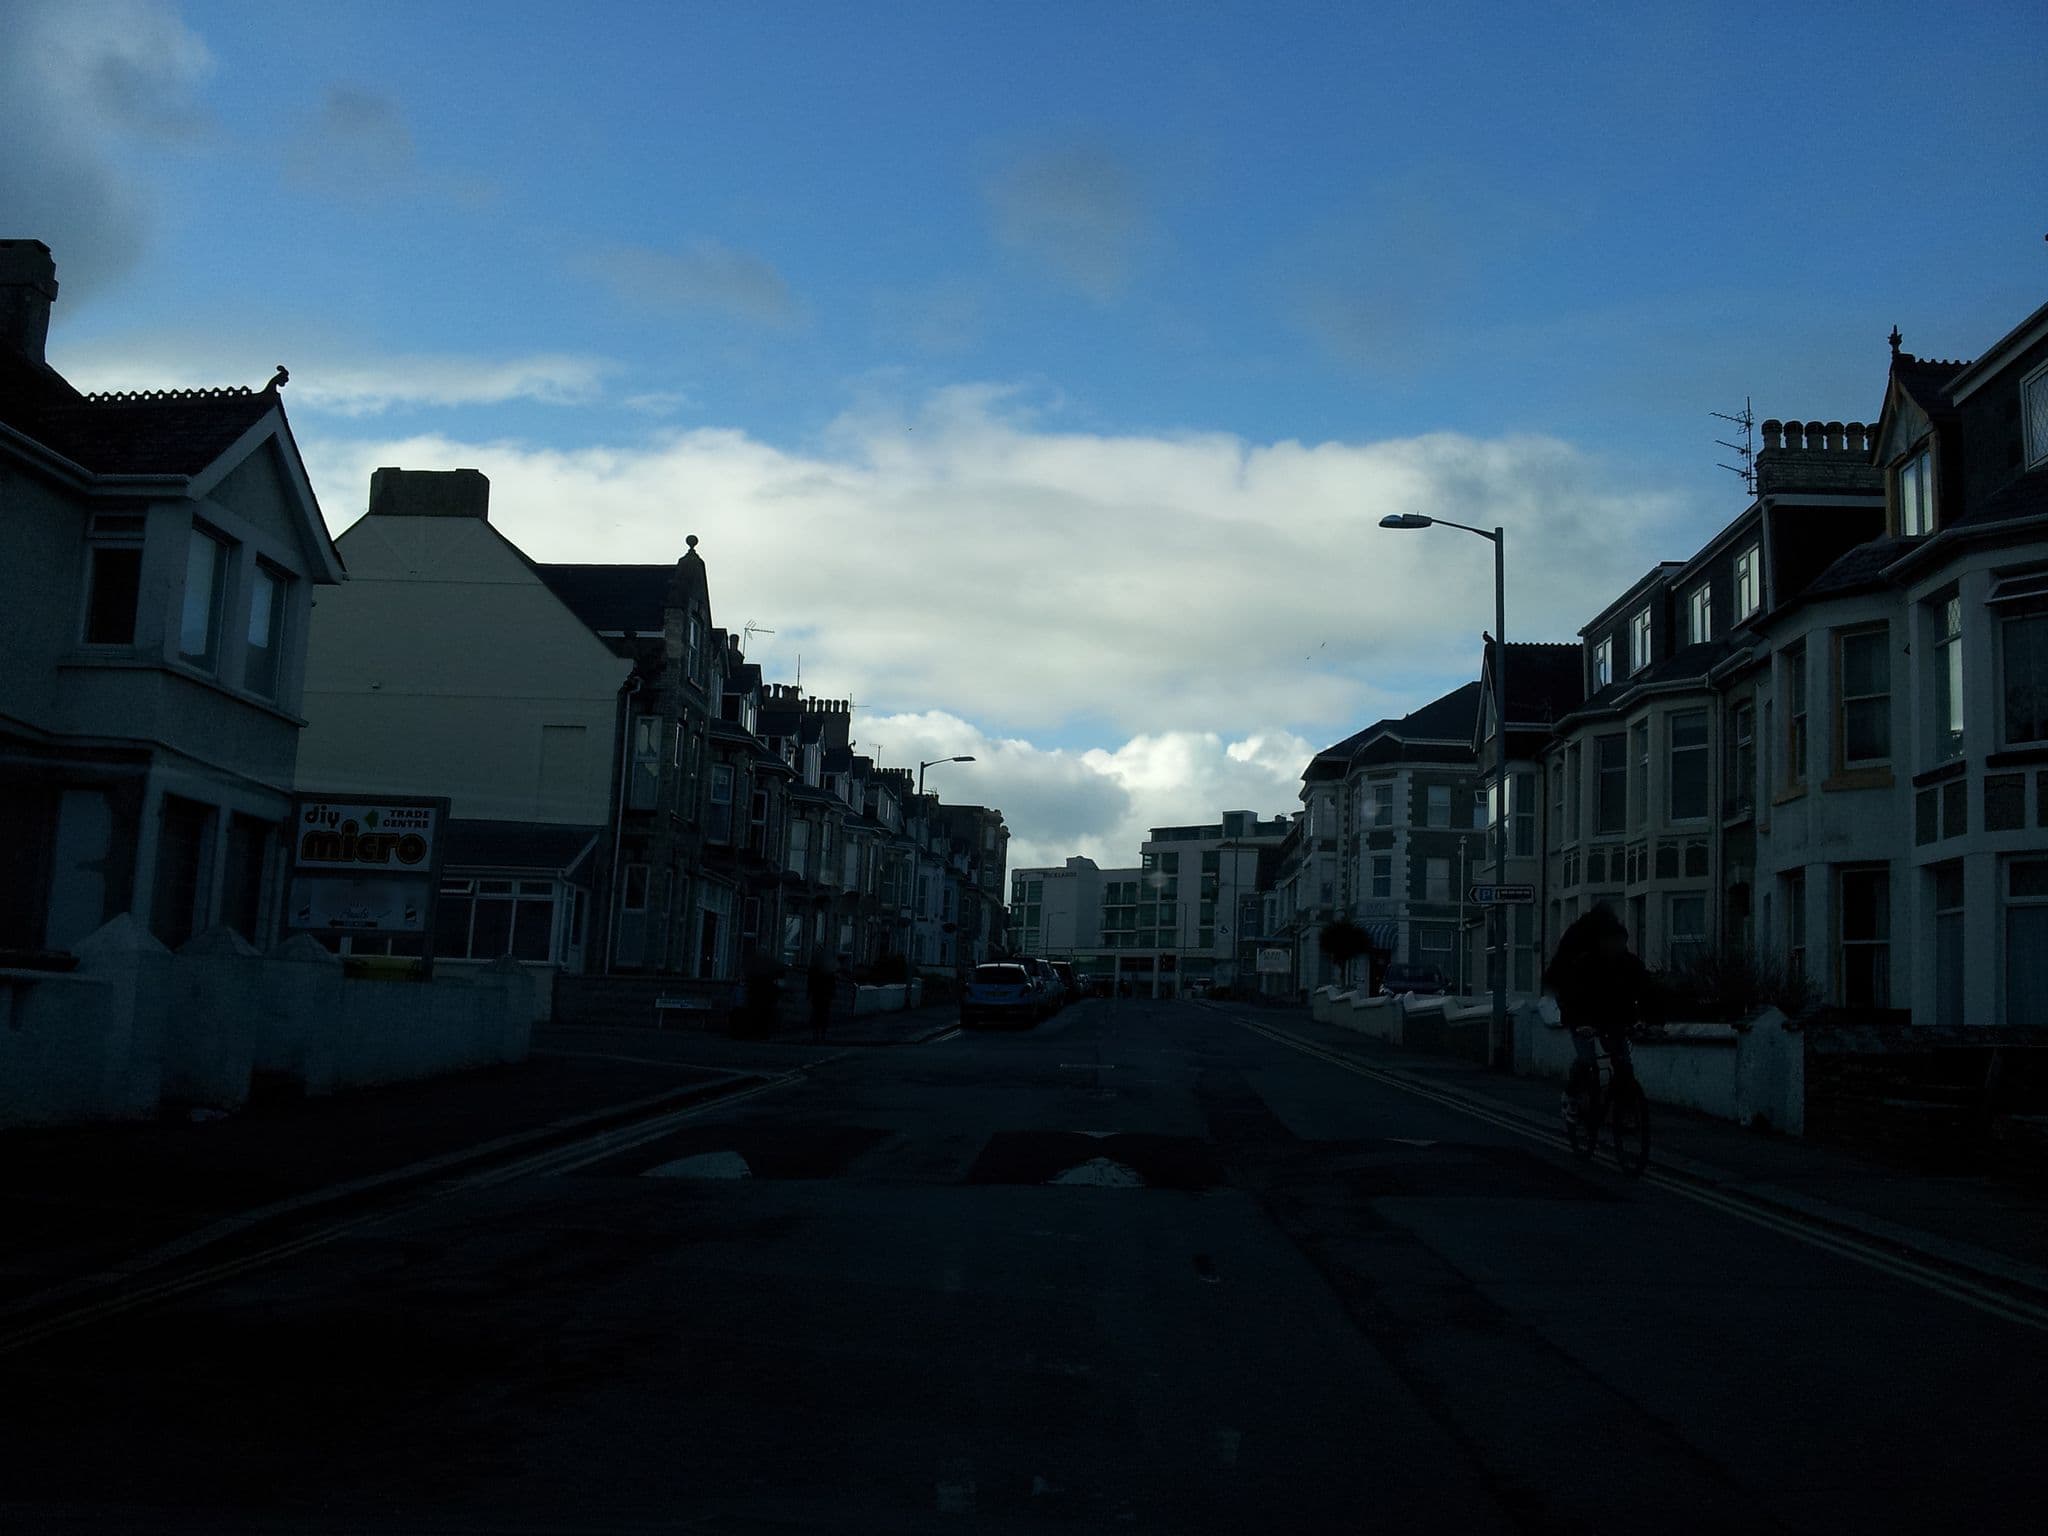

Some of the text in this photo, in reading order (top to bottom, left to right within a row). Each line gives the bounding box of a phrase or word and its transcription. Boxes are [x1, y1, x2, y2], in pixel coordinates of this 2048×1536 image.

[305, 806, 340, 828] diy
[390, 810, 430, 819] TRADE
[383, 819, 429, 828] CENTRE
[302, 820, 427, 864] micro
